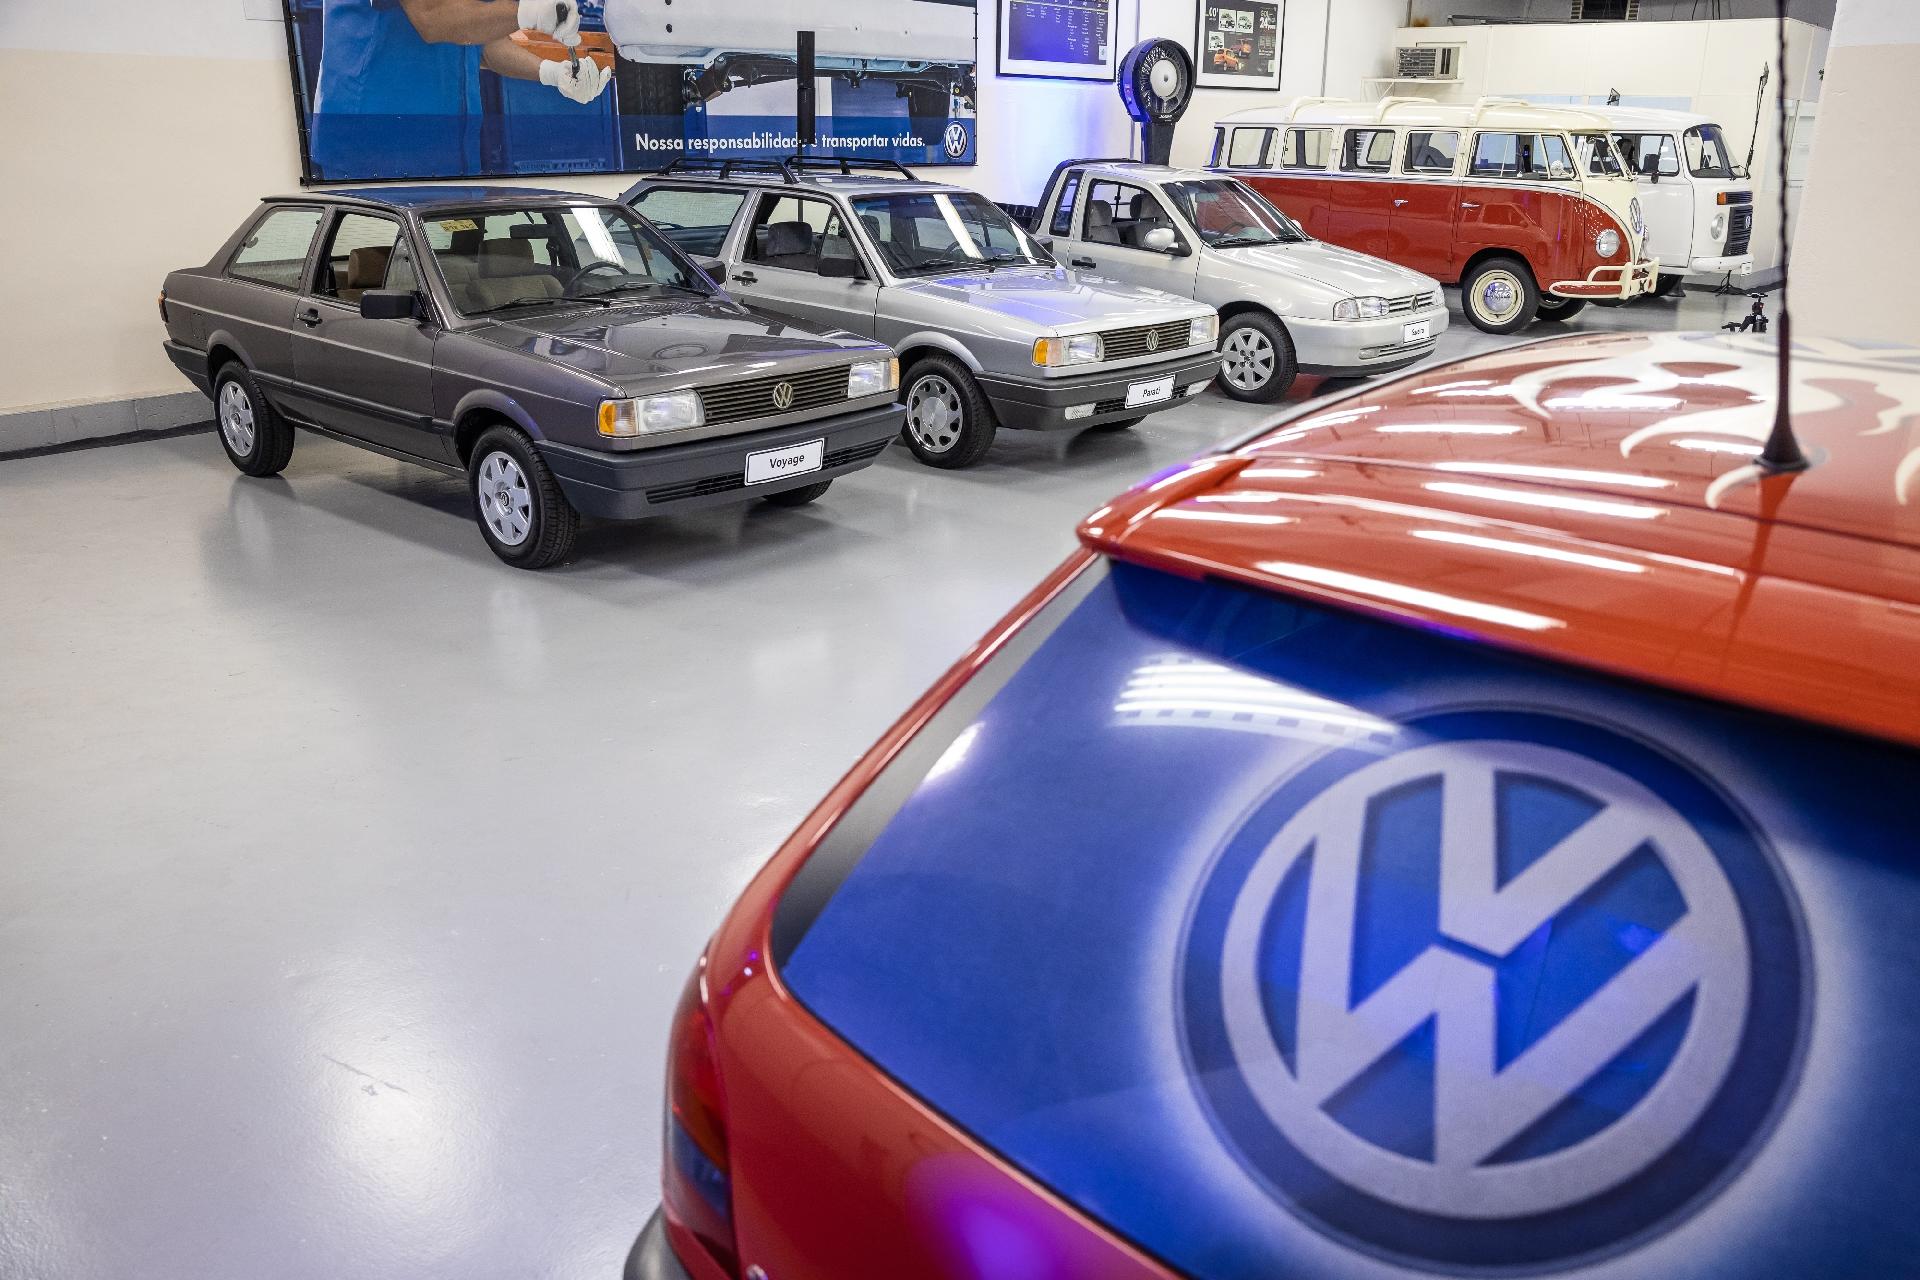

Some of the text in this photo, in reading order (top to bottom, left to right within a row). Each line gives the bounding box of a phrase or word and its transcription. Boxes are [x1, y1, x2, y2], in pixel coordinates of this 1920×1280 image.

[635, 133, 684, 151] Nossa
[688, 131, 806, 154] responsabilidad
[822, 134, 889, 151] transportar
[892, 132, 926, 147] vidas.
[769, 454, 805, 469] Voyage
[1221, 738, 1752, 1220] VW
